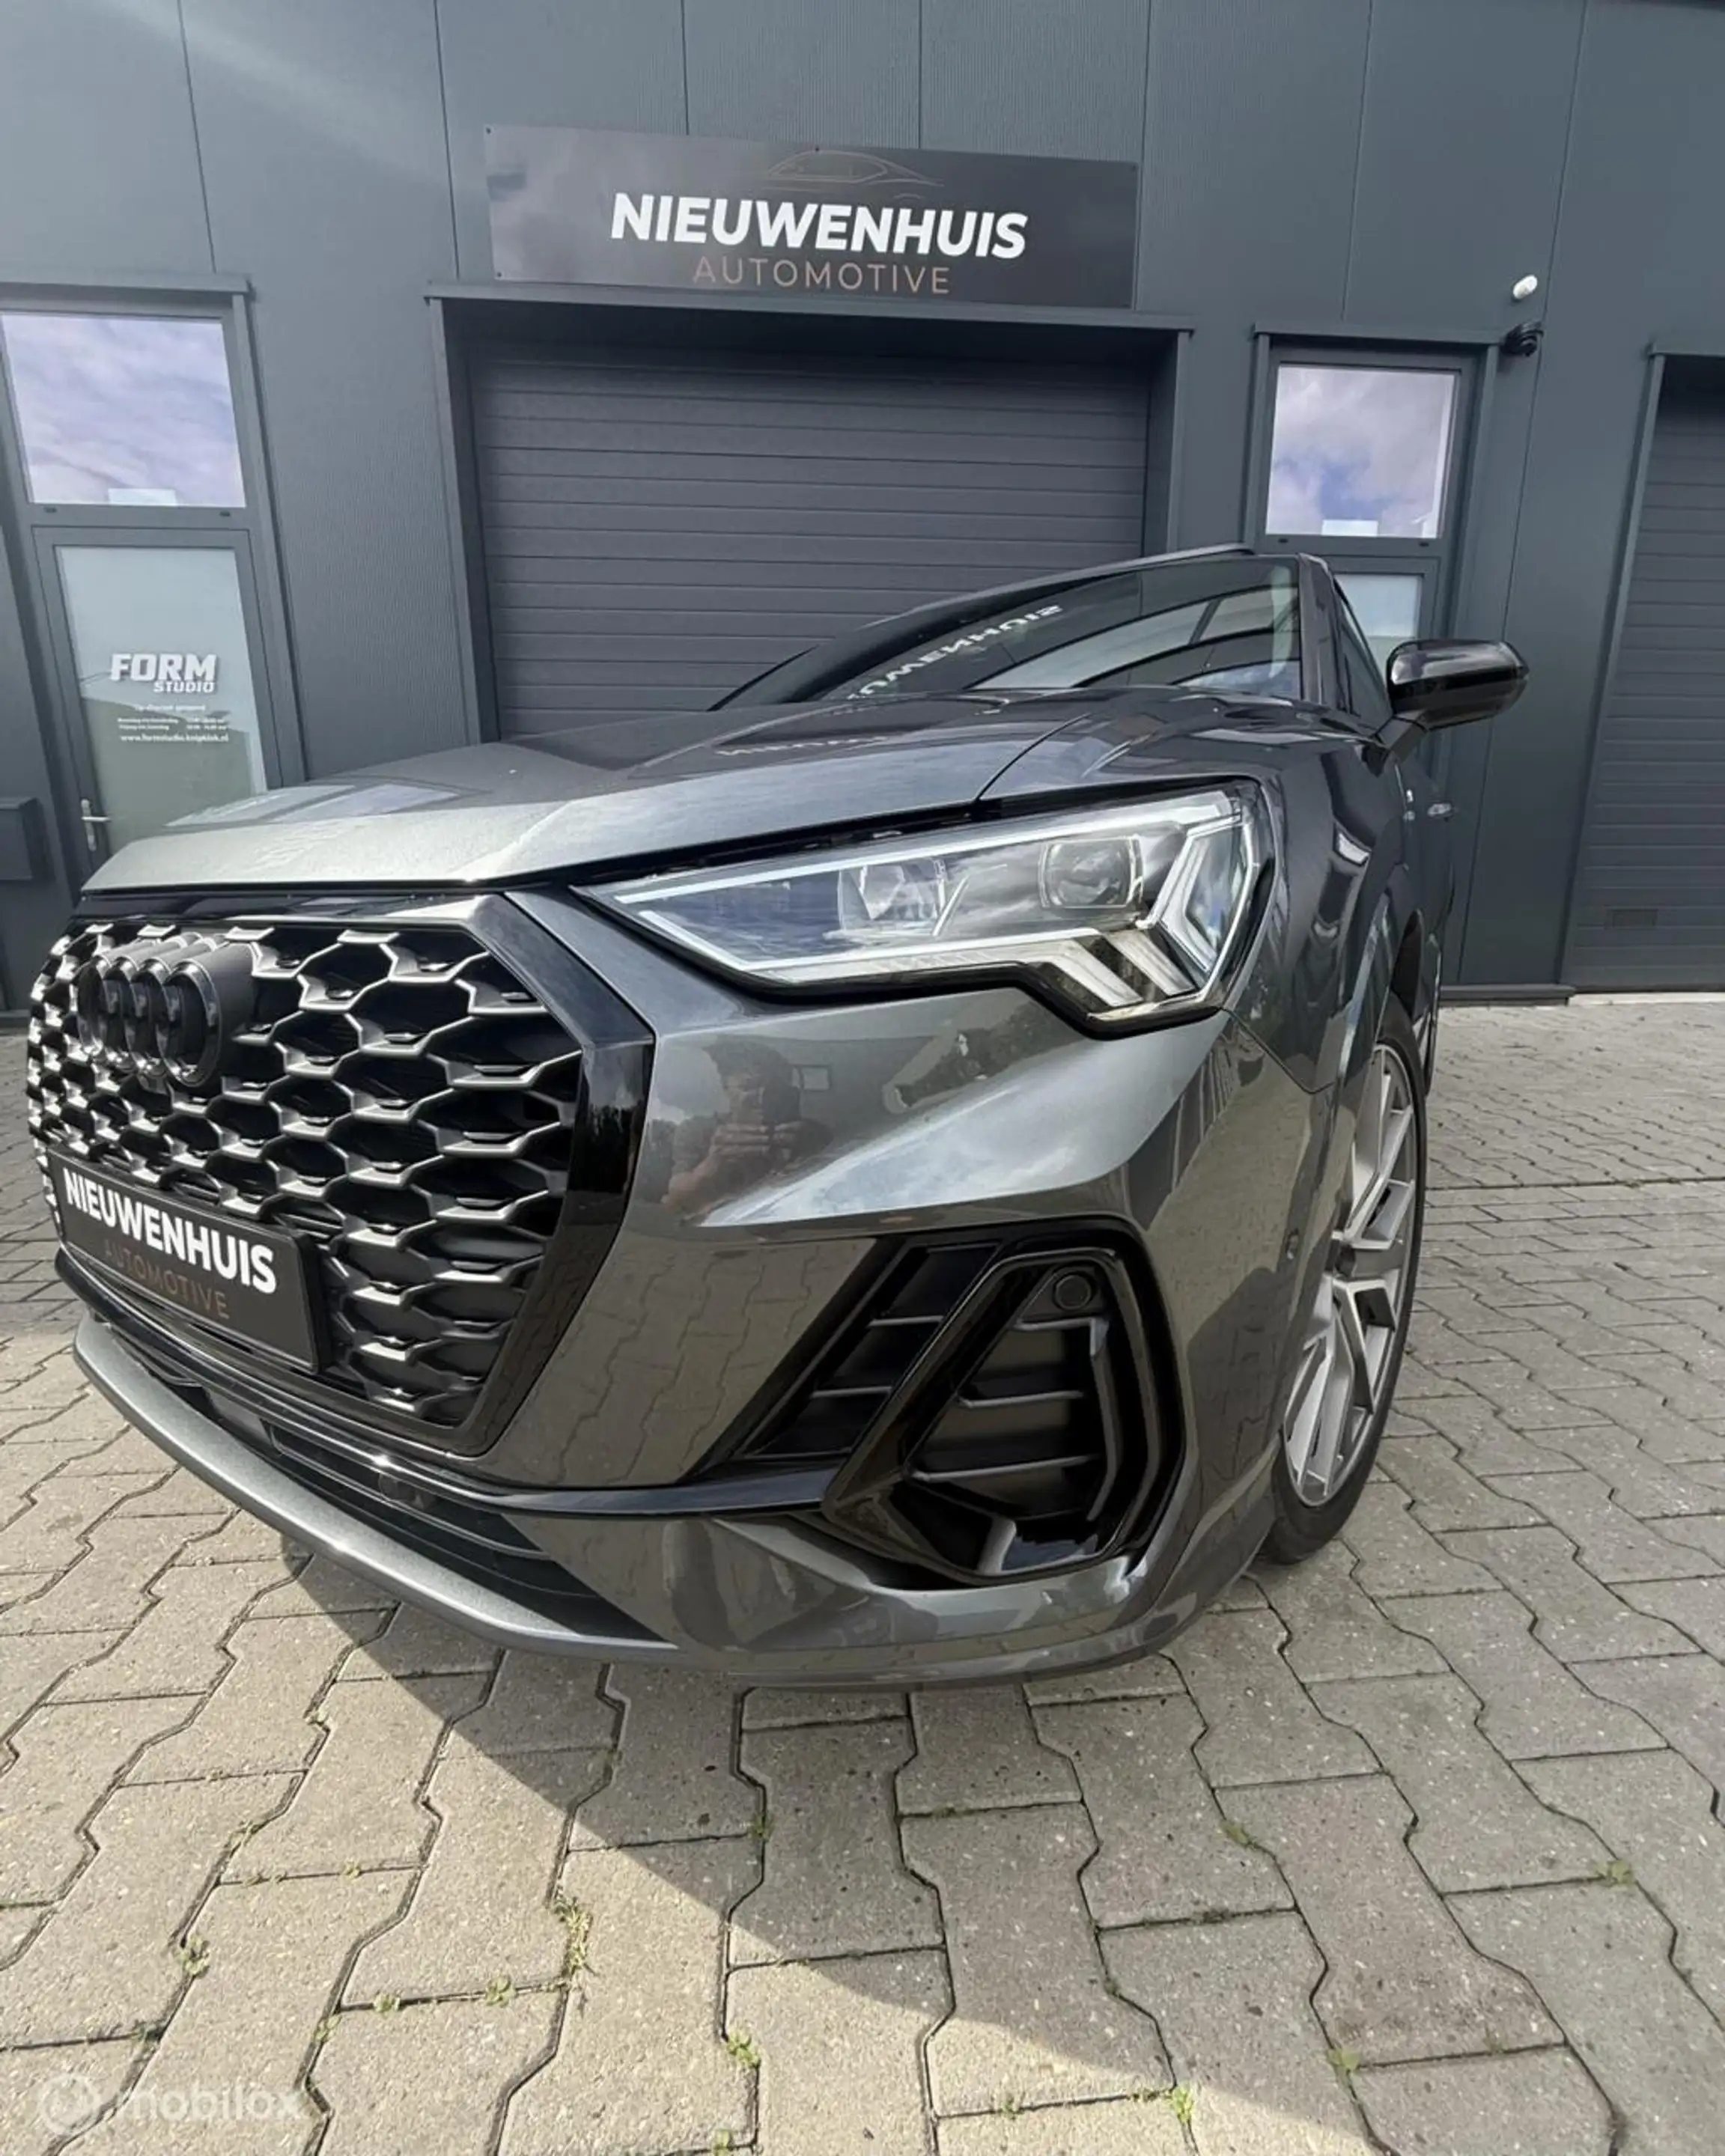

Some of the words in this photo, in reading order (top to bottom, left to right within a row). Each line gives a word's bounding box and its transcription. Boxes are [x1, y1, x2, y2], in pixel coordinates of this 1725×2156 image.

[610, 192, 1029, 260] NIEUWENHUIS
[693, 256, 950, 295] AUTOMOTIVE
[109, 653, 218, 682] FORM
[153, 680, 216, 694] STUDIO
[63, 1167, 277, 1295] NIEUWENHUIS
[104, 1239, 231, 1321] AUTOMOTIVE
